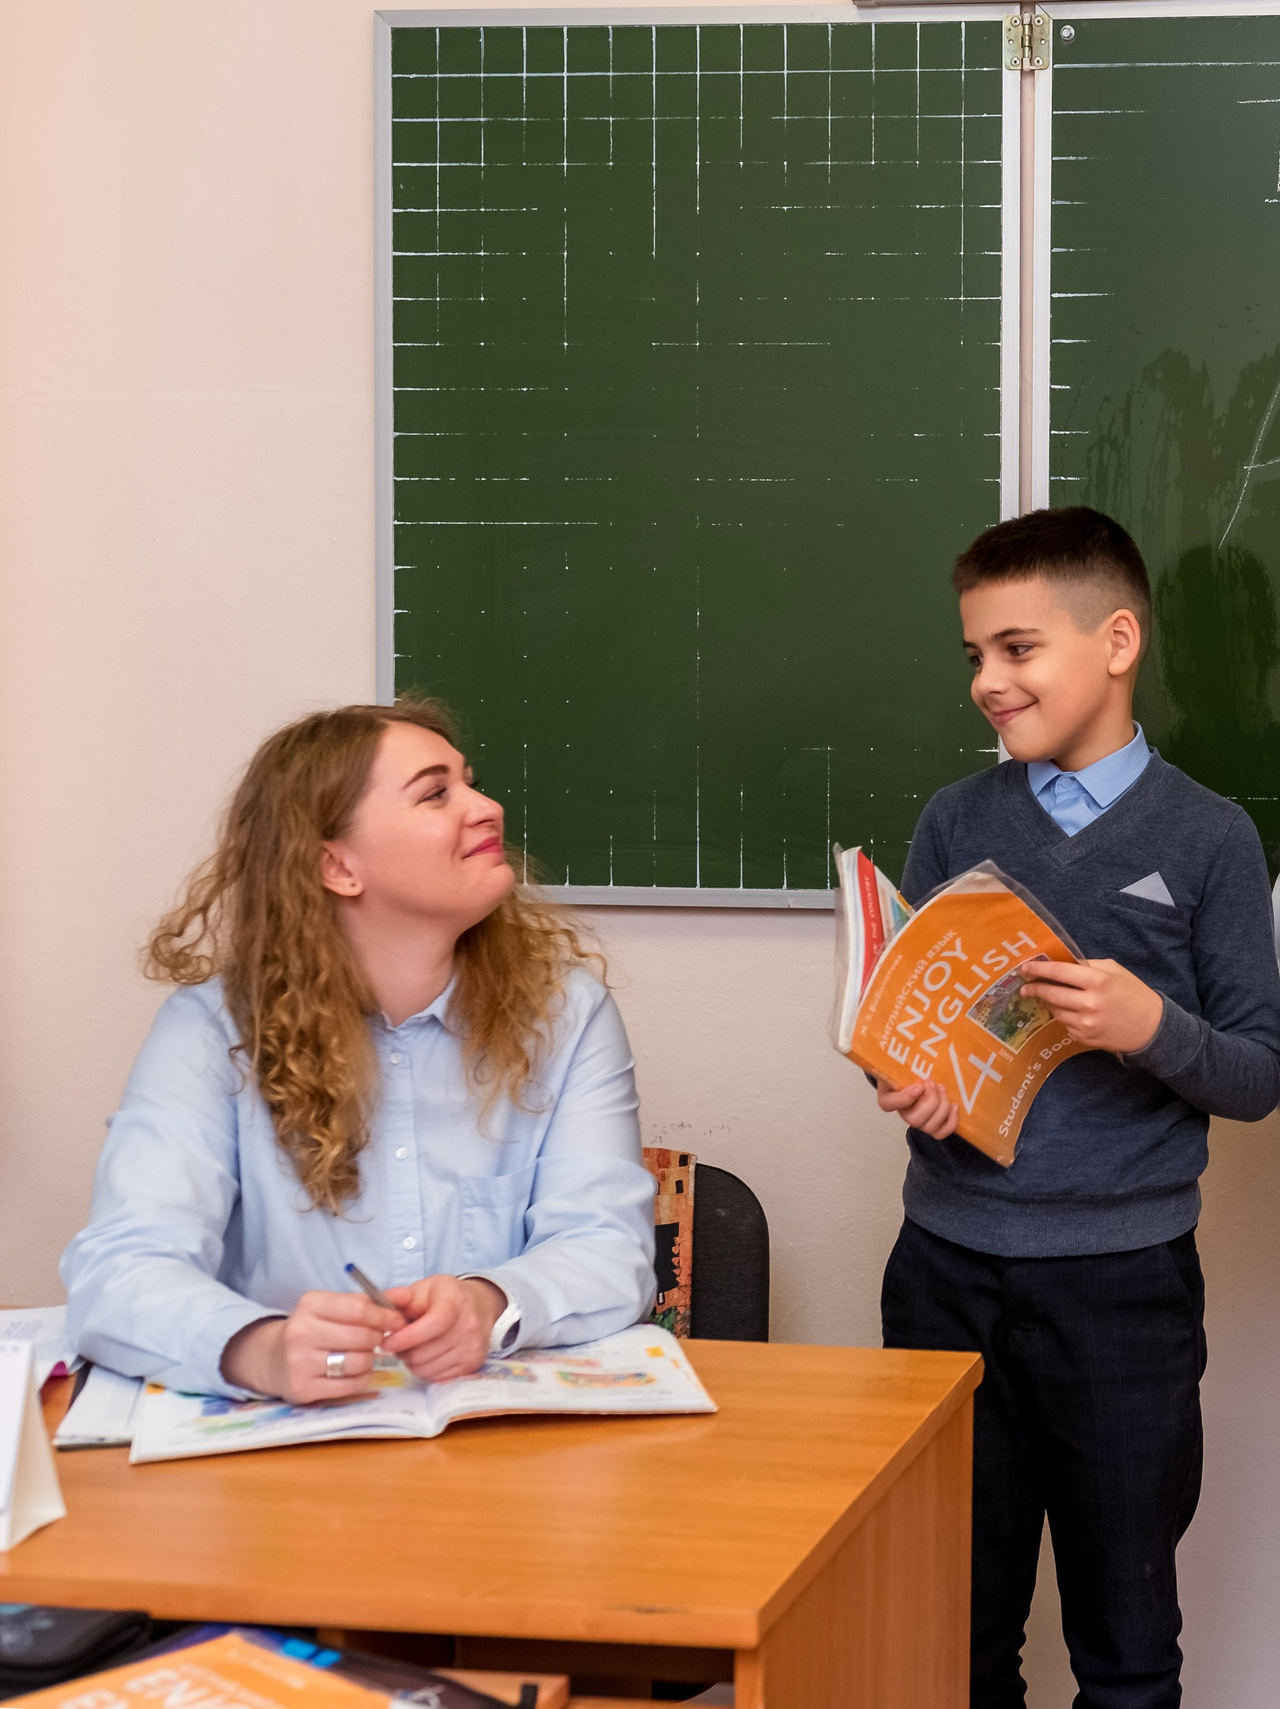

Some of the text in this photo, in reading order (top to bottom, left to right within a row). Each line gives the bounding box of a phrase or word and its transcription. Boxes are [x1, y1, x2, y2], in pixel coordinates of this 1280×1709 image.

[879, 958, 928, 1051] АНГЛИЙСКИЙ
[926, 928, 958, 961] ЯЗЫК
[887, 937, 969, 1066] ENJOY
[910, 930, 1038, 1081] ENGLISH
[948, 1042, 1004, 1115] 4
[999, 1062, 1042, 1138] Student's
